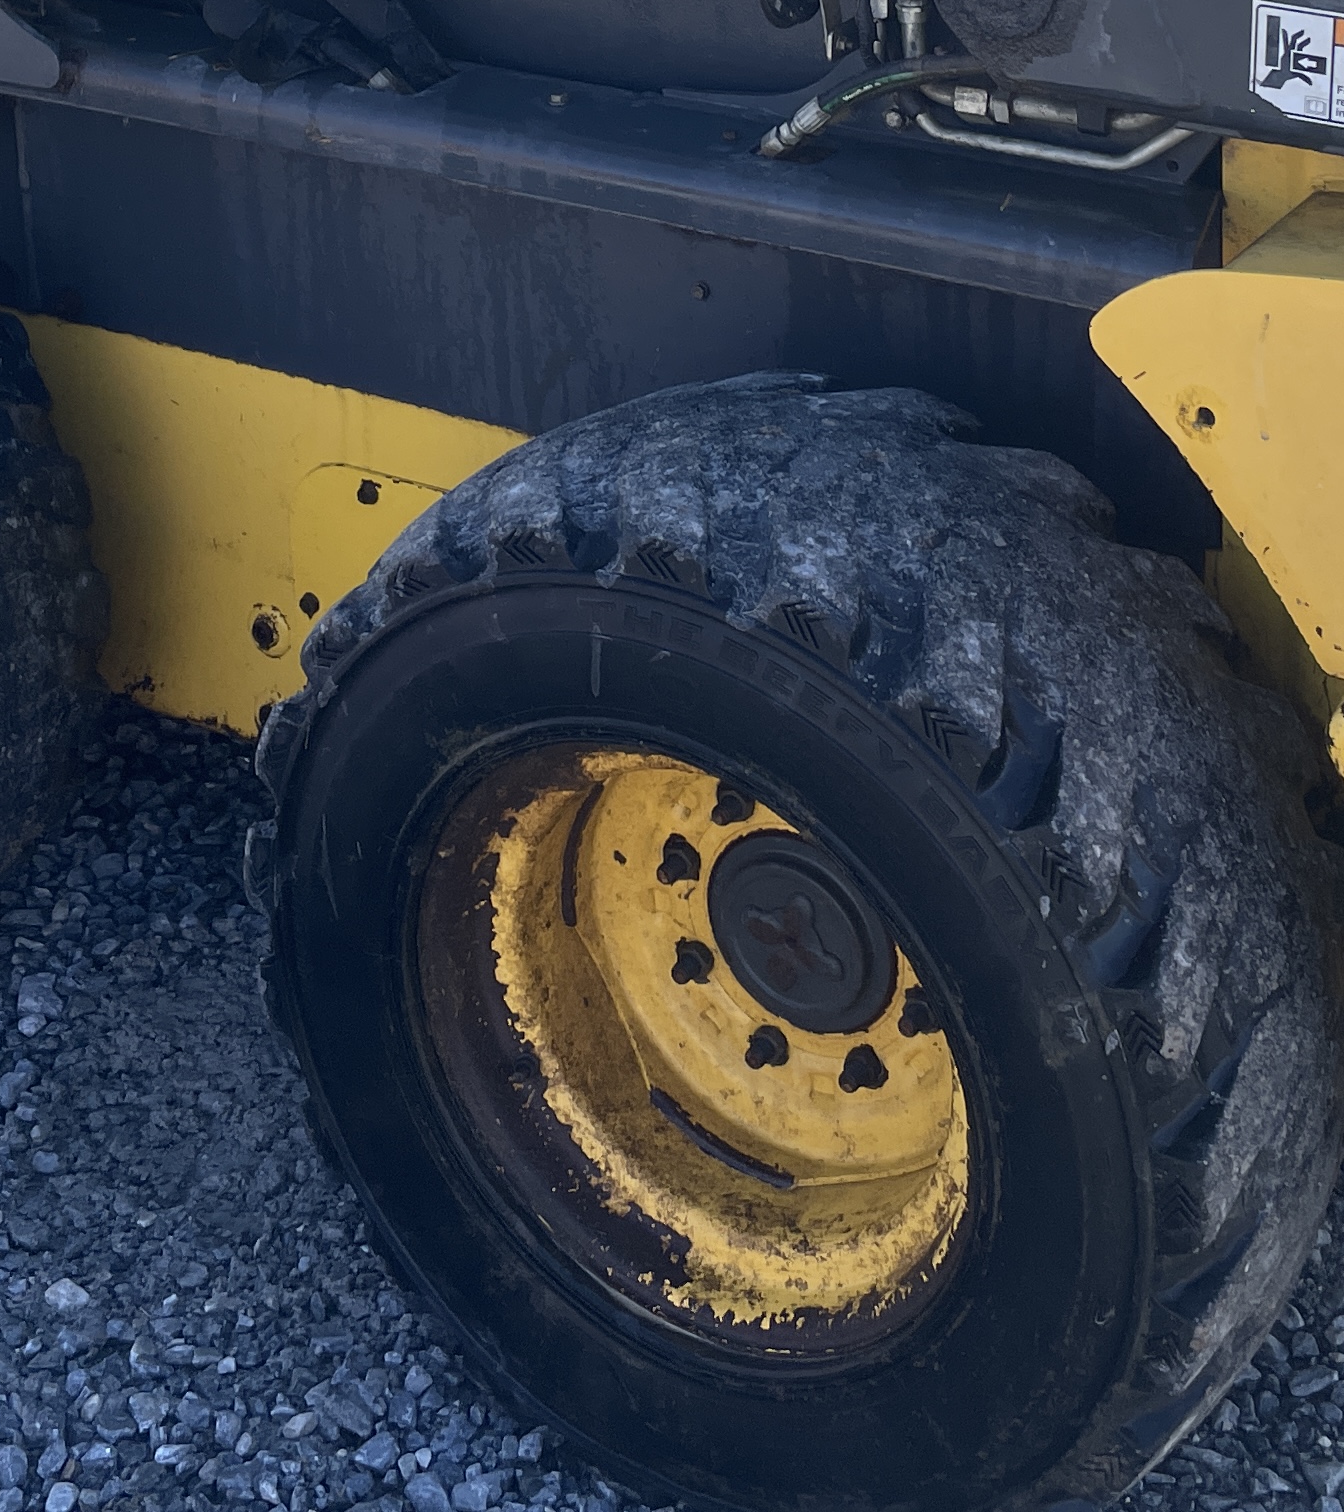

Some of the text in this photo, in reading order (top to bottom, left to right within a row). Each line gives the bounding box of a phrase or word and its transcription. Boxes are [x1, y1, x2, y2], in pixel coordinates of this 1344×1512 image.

[575, 596, 1053, 964] THE BEEFY BABY
